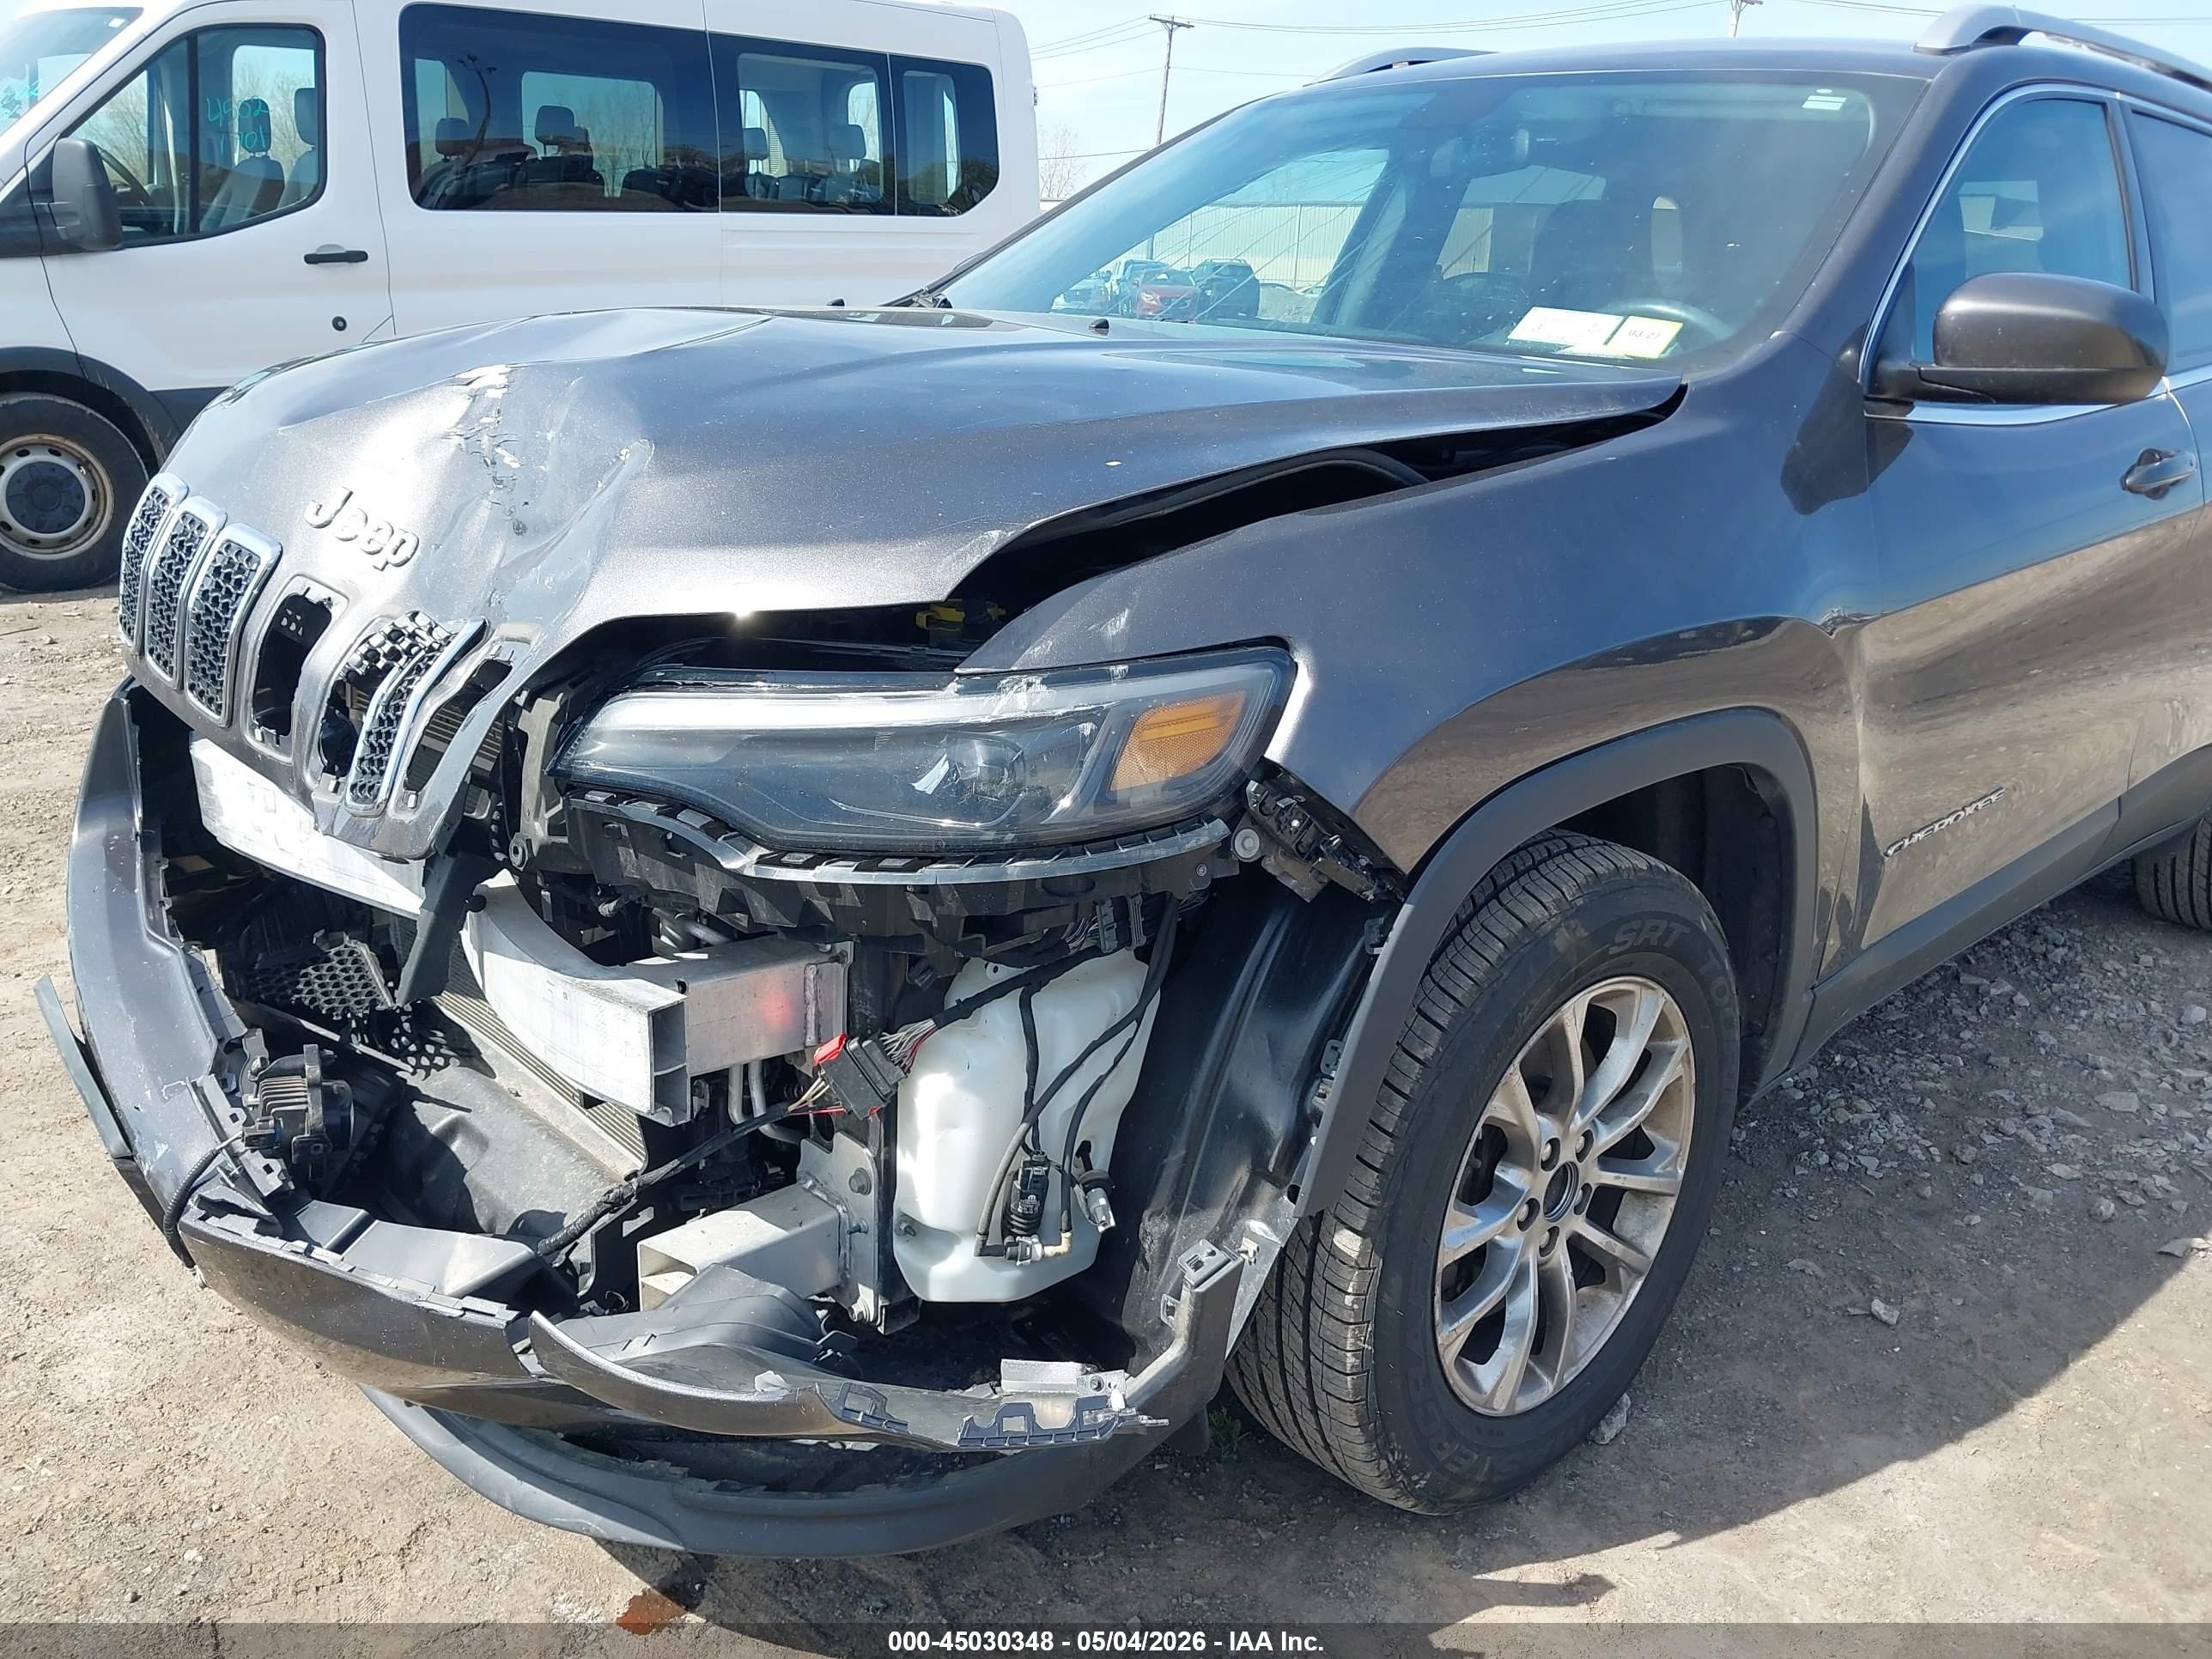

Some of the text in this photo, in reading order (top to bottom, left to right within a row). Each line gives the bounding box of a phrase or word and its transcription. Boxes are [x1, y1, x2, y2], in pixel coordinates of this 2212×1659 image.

[206, 96, 272, 127] 4502
[303, 487, 419, 571] Jeep
[1608, 918, 1690, 955] SRT
